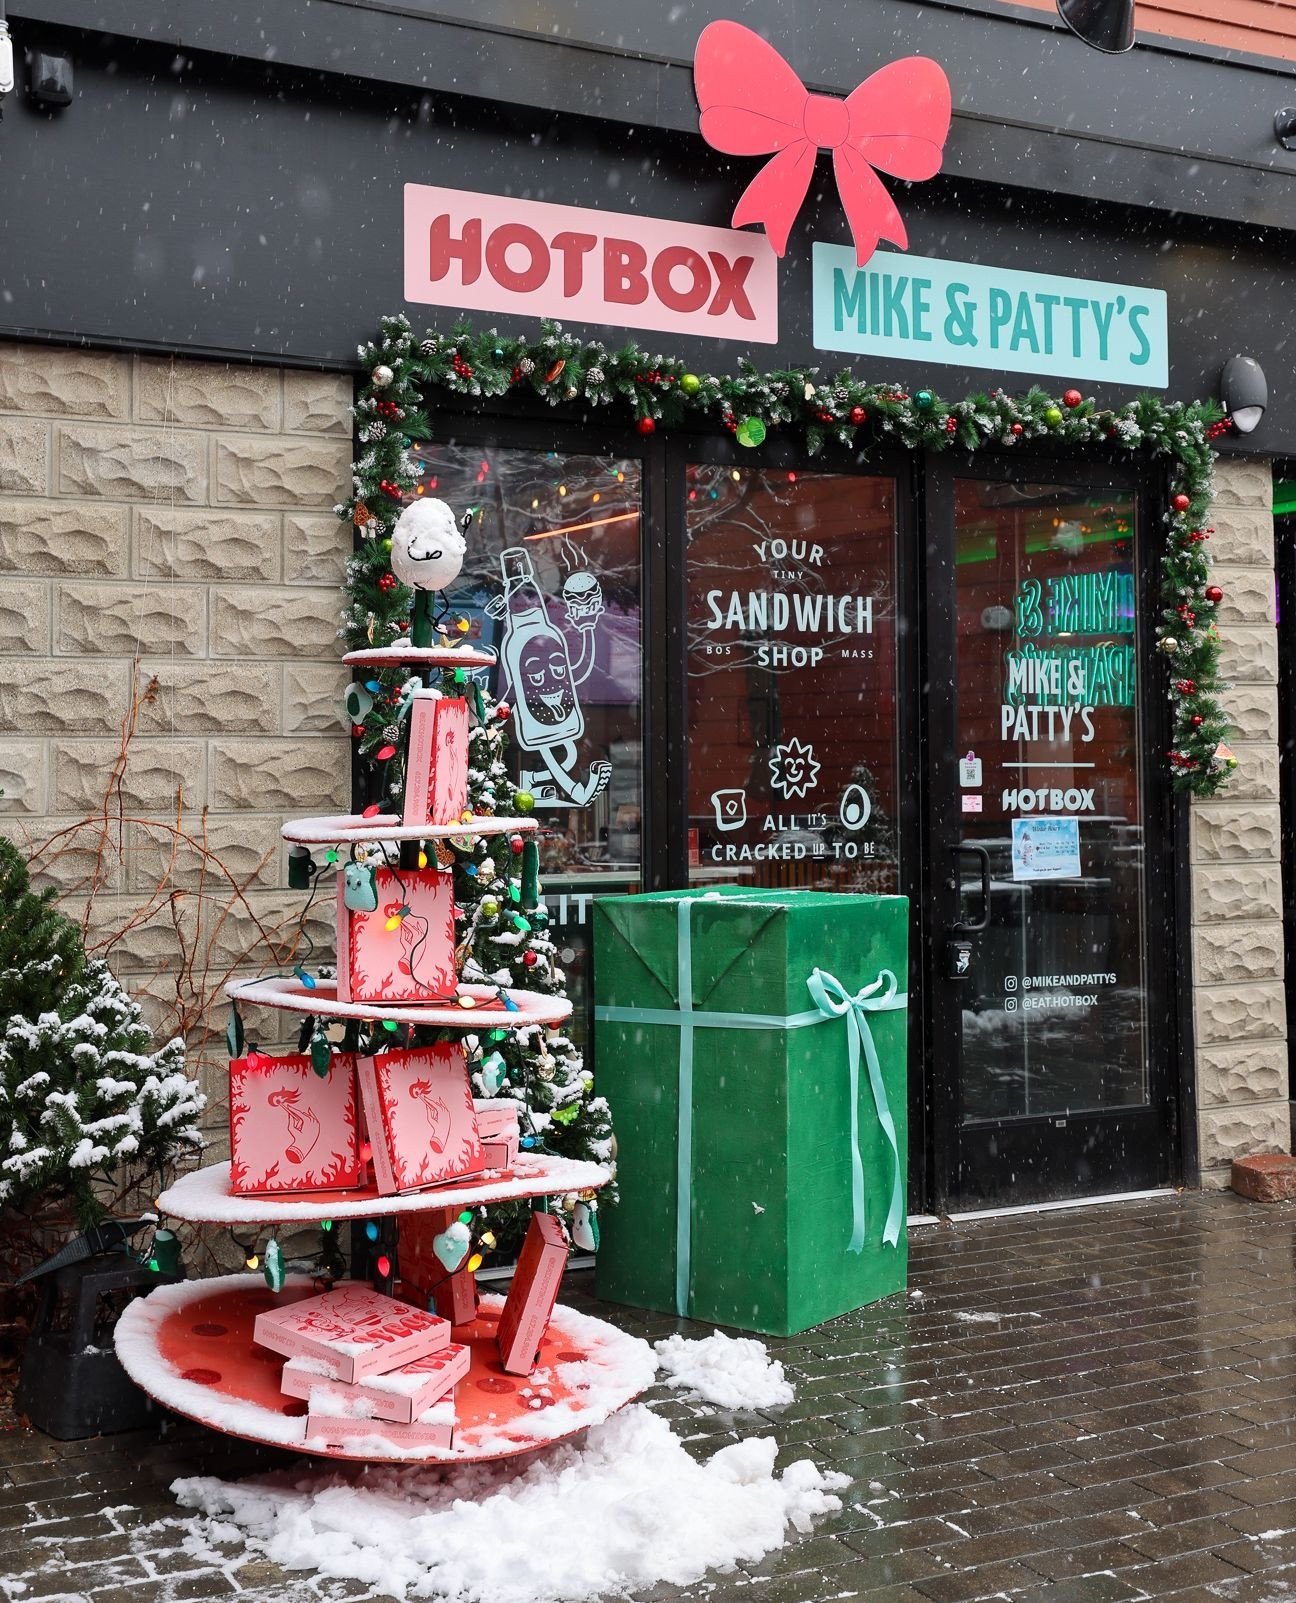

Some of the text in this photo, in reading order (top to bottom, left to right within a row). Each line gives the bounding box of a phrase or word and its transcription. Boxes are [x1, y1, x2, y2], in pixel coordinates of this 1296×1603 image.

[429, 213, 756, 321] HOTBOX
[832, 266, 1151, 366] MIKE & PATTY'S
[752, 538, 824, 567] YOUR
[773, 570, 803, 580] TINY
[706, 589, 873, 634] SANDWICH
[706, 646, 874, 667] BOS SHOP MASS
[1009, 657, 1086, 696] MIKE &
[1001, 702, 1095, 742] PATTY'S
[1002, 788, 1096, 811] HOTBOX
[763, 812, 827, 831] ALL IT'S
[711, 841, 875, 861] CRACKED UP TO BE
[1022, 973, 1117, 988] @MIKEANDPATTYS
[1022, 995, 1098, 1009] @EAT.HOTBOX
